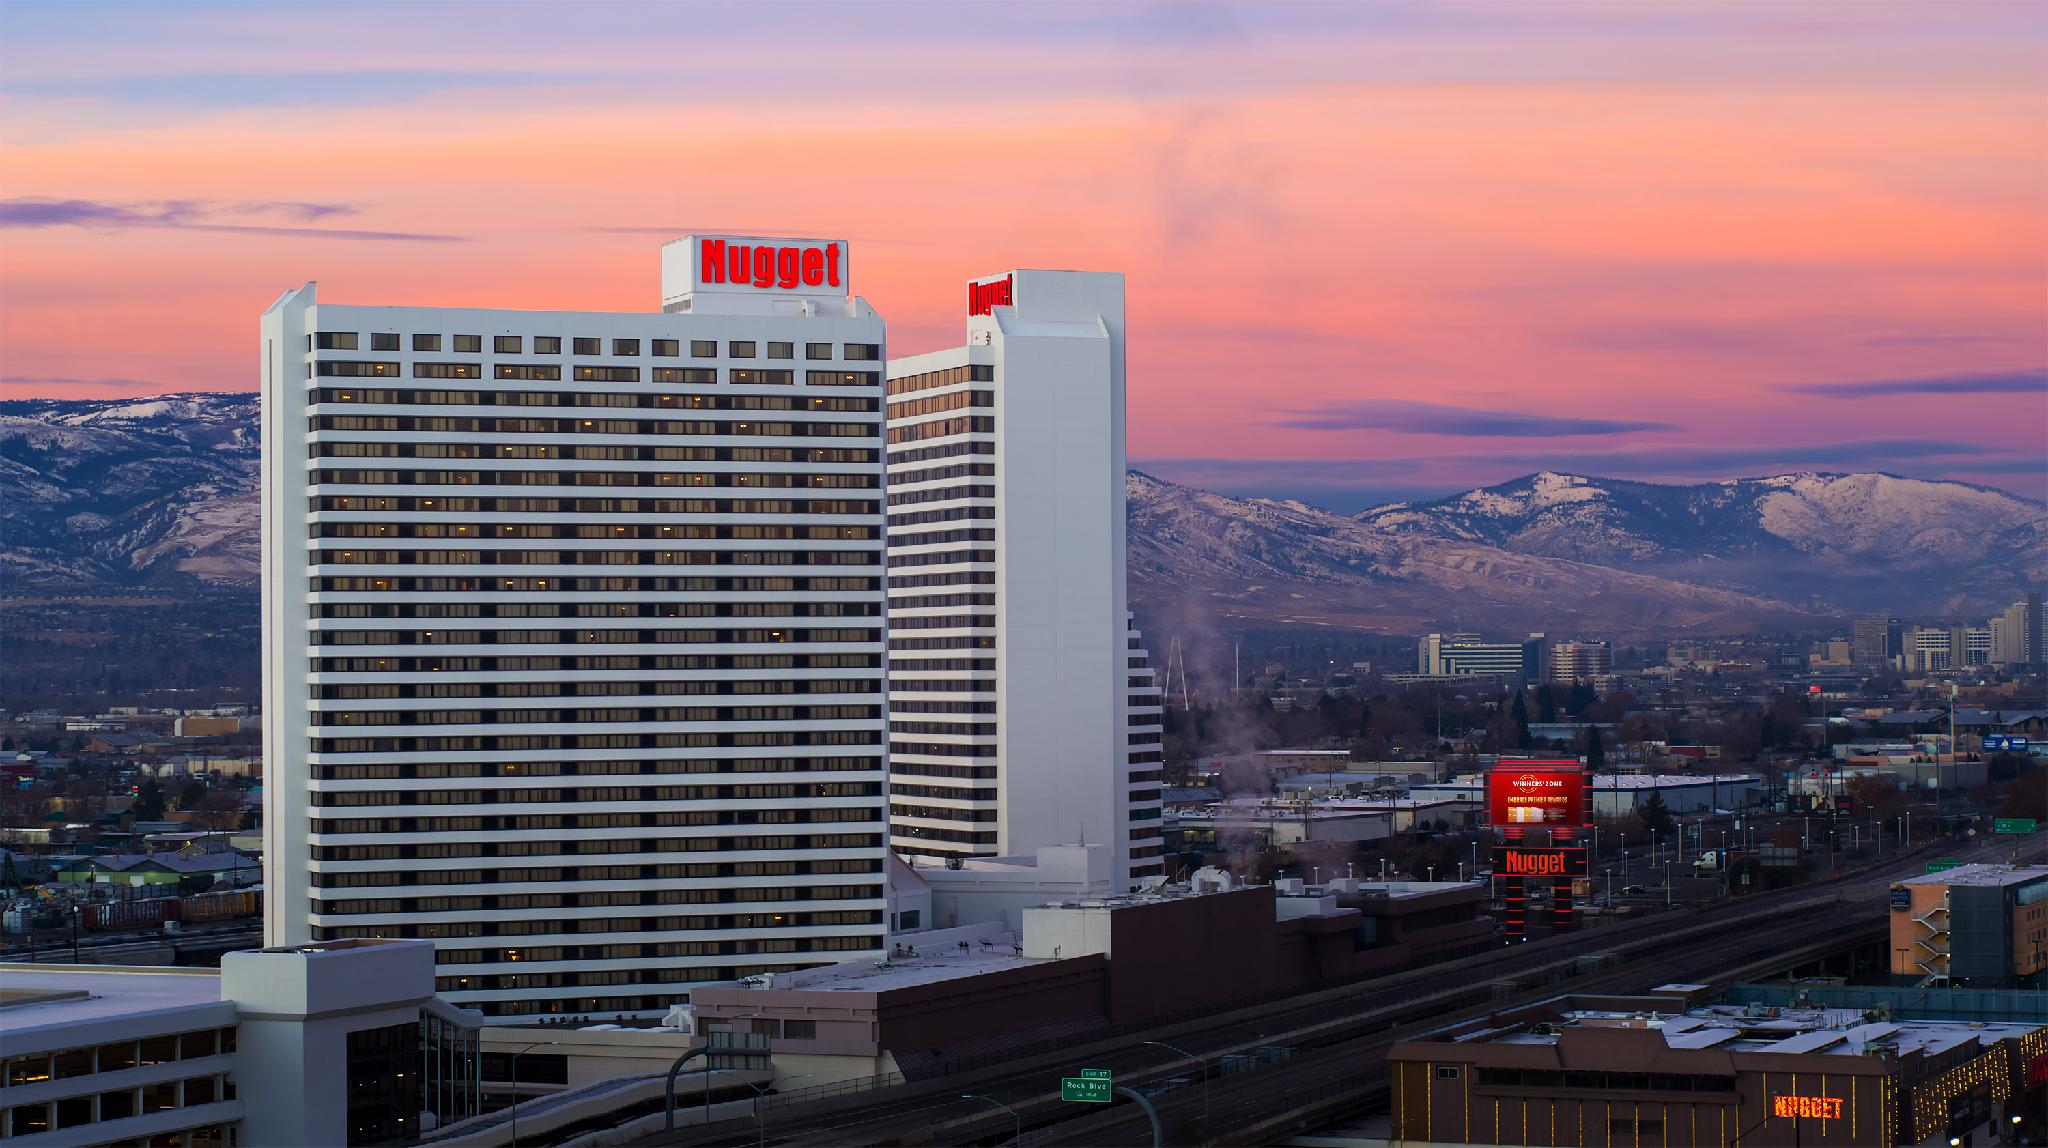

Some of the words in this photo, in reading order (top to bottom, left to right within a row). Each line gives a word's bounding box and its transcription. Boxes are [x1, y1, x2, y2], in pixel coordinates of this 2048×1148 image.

[701, 239, 840, 289] Nugget
[1506, 850, 1566, 875] Nugget
[1067, 1081, 1086, 1089] Rock
[1089, 1082, 1106, 1090] Blvd
[1774, 1095, 1844, 1120] NUGGET
